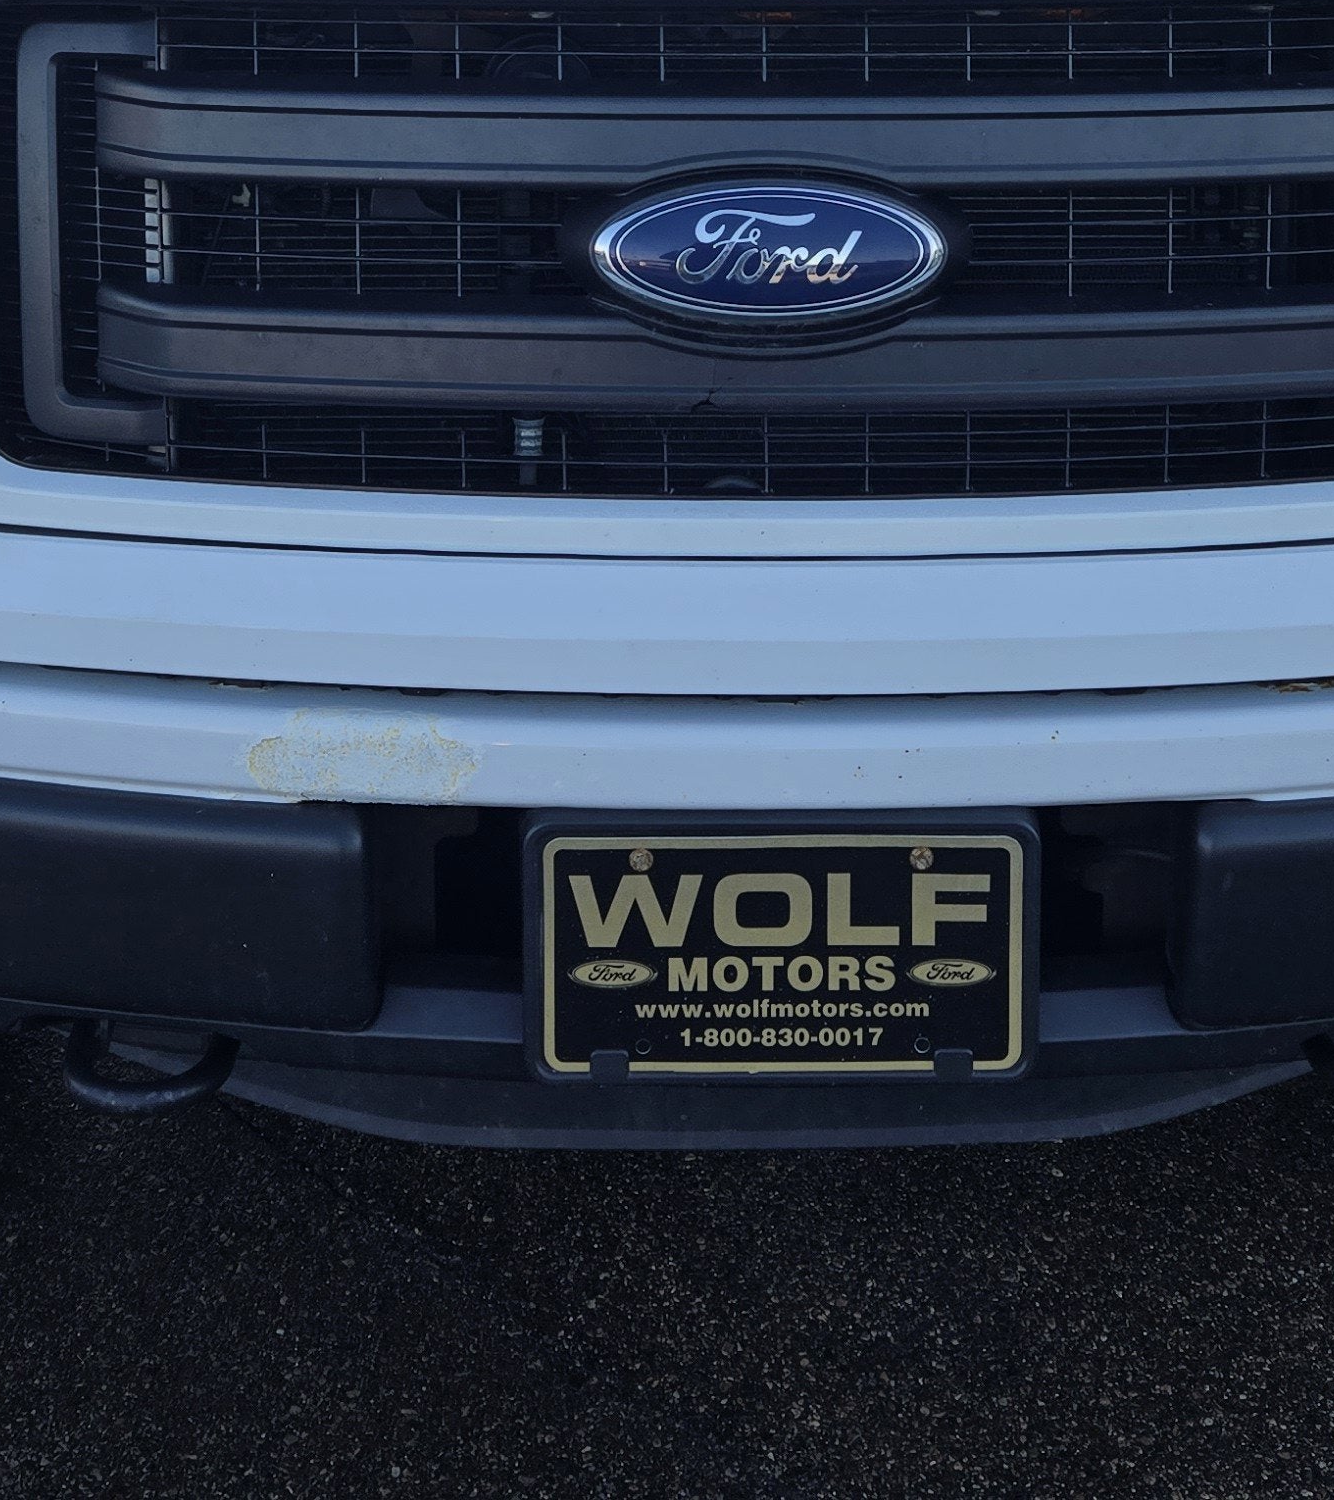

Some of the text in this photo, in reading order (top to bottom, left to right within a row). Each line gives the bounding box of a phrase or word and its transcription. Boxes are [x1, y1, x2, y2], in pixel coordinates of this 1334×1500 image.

[676, 209, 863, 285] Ford
[568, 872, 991, 948] WOLF
[586, 964, 638, 983] Ford
[667, 955, 897, 992] MOTORS
[924, 963, 975, 982] Ford
[635, 999, 930, 1019] www.wolfmotors.com
[680, 1027, 884, 1047] 1-800-830-0017
